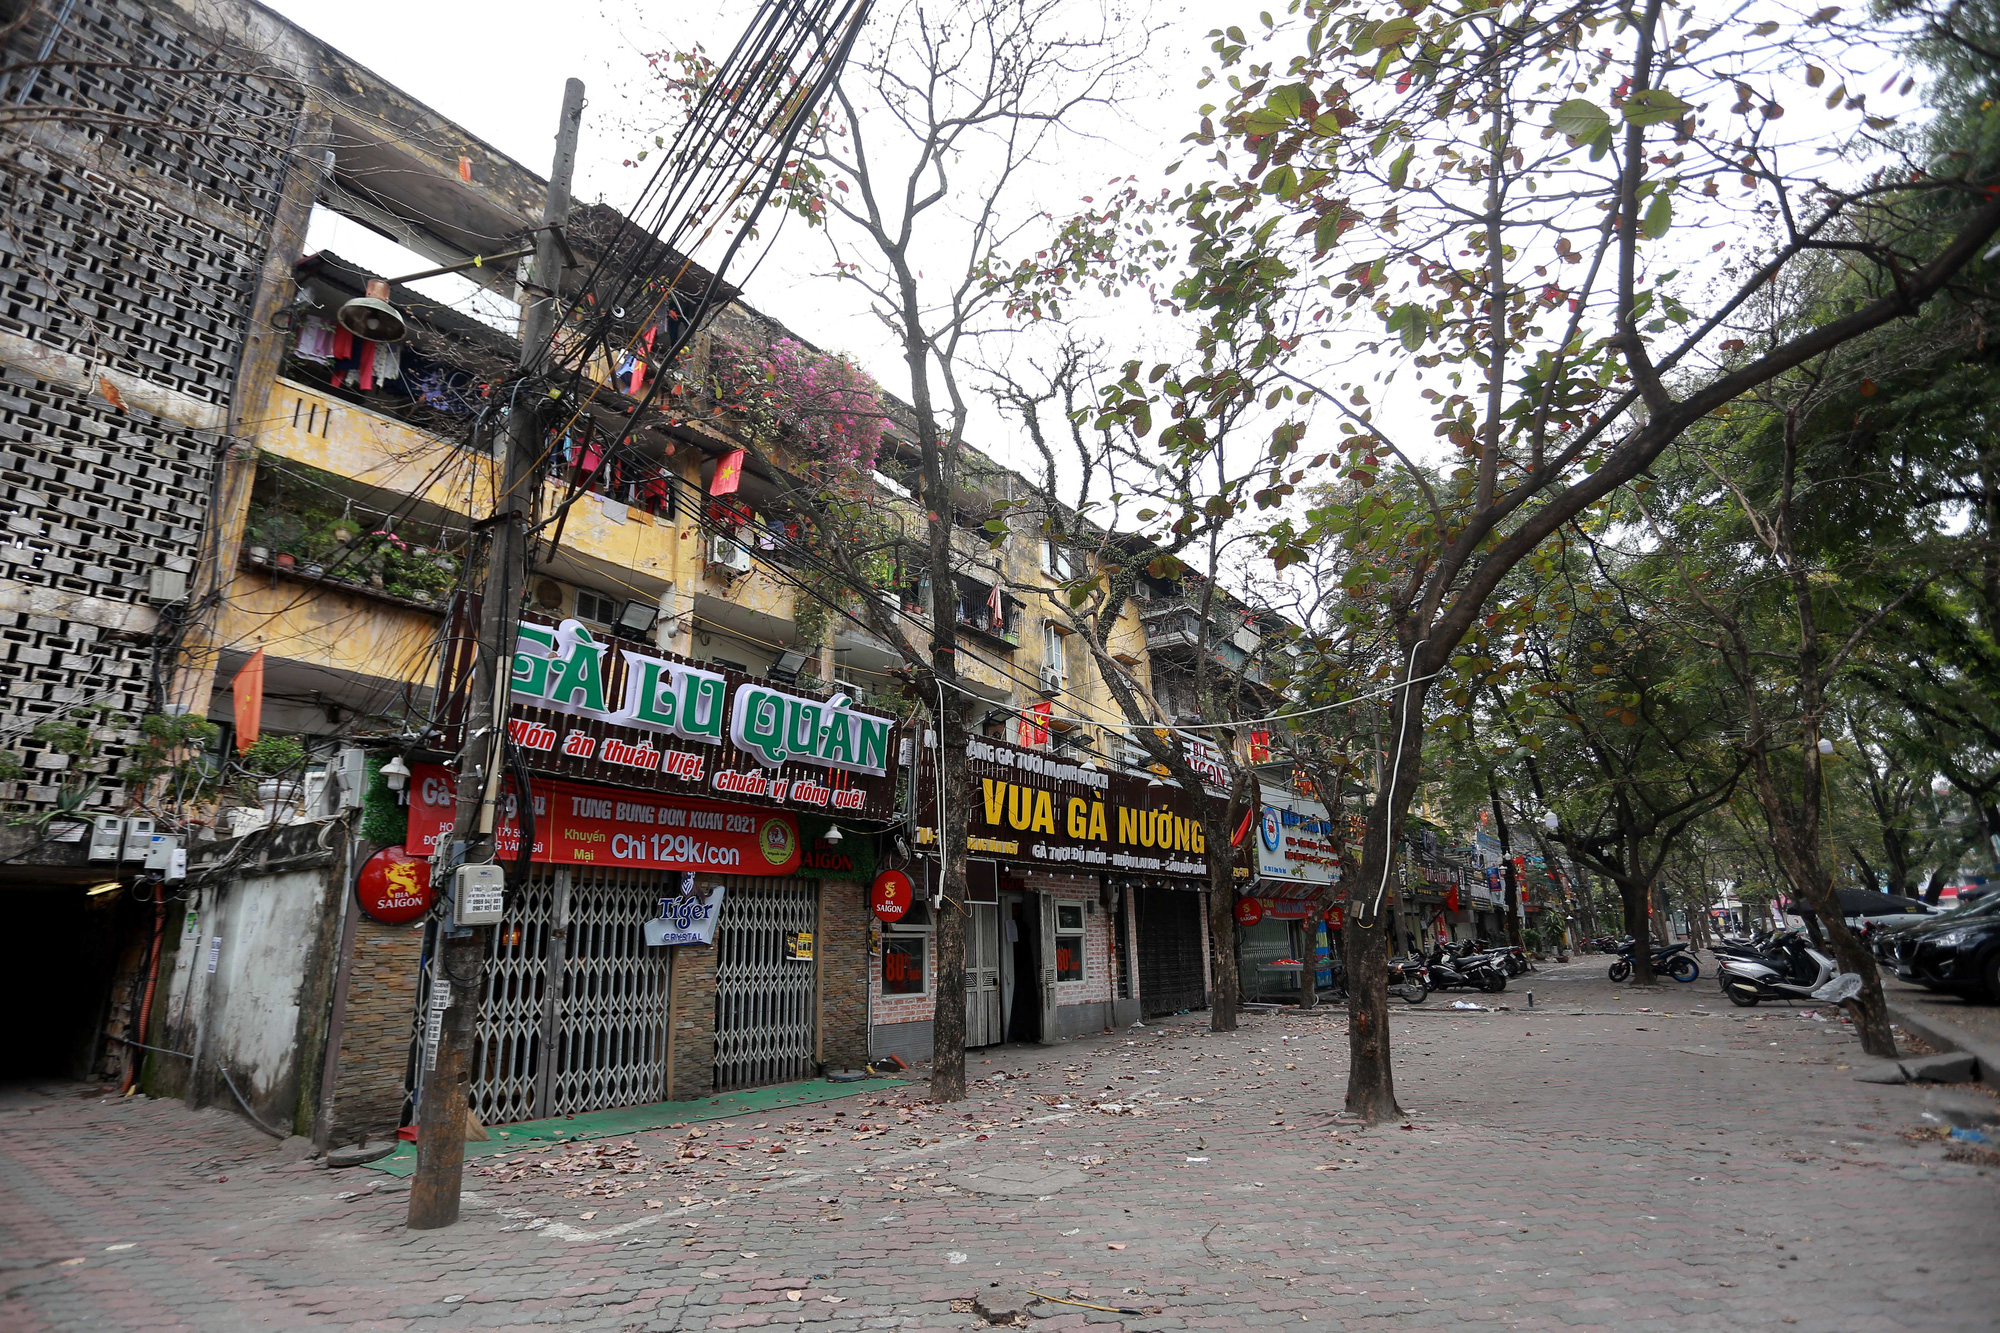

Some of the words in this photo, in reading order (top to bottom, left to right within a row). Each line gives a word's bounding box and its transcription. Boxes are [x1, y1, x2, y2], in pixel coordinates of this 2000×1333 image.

[742, 690, 890, 771] QUÁN
[508, 718, 556, 750] Món
[564, 731, 598, 759] ăn
[602, 740, 661, 770] thuần
[717, 770, 767, 796] chuẩn
[772, 779, 788, 803] vị
[794, 780, 830, 806] đồng
[835, 788, 867, 810] quê!
[422, 777, 450, 807] Gà
[726, 814, 757, 834] 2021
[982, 778, 1055, 834] VUA
[1067, 791, 1108, 842] GÀ
[1118, 804, 1205, 854] NƯỚNG
[564, 828, 606, 844] Khuyến
[573, 848, 594, 863] Mại
[611, 833, 647, 860] Chỉ
[1032, 840, 1048, 859] GÀ
[799, 852, 852, 872] AIGON
[377, 897, 423, 910] SAIGON
[394, 891, 410, 899] BIA
[657, 895, 714, 931] Tiger
[876, 903, 903, 914] SAIGON
[662, 932, 704, 943] CRYSTAL
